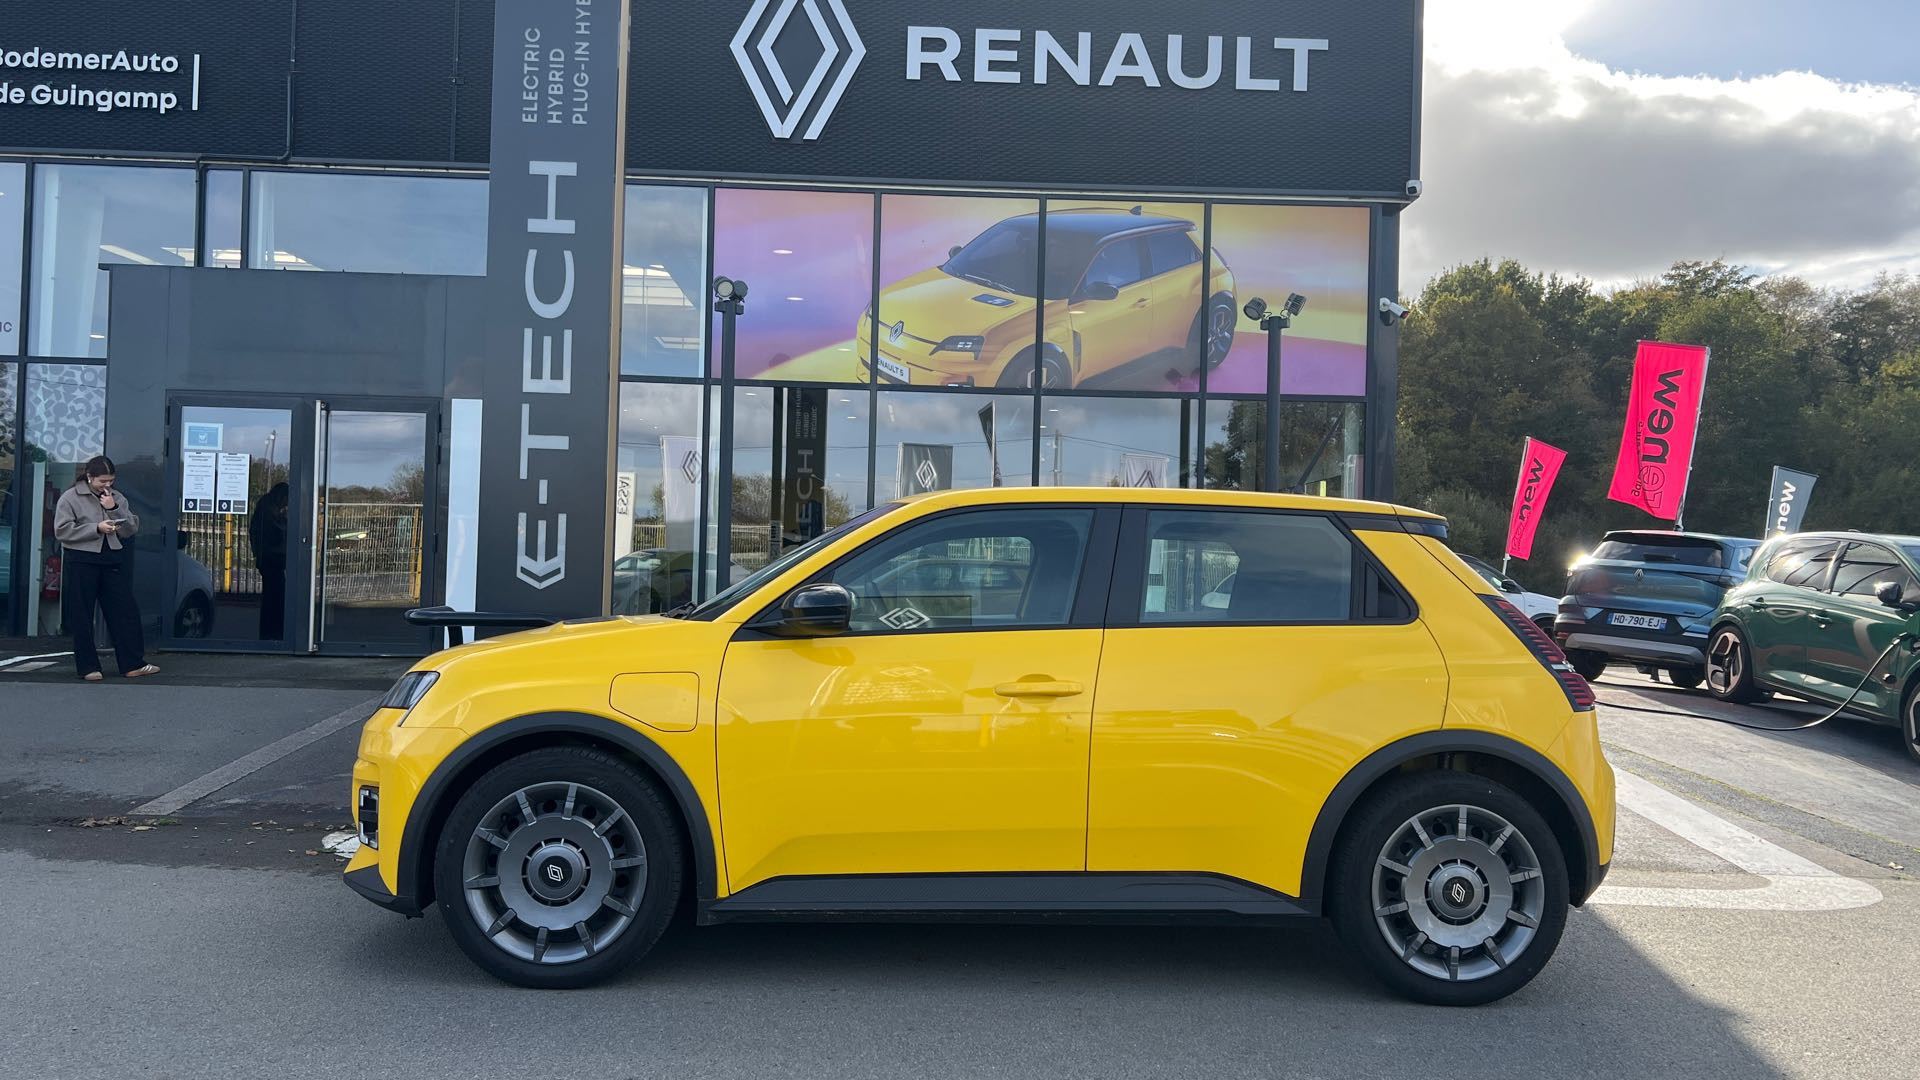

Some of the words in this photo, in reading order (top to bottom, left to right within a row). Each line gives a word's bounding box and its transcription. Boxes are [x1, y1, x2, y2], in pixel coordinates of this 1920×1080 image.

[0, 46, 179, 72] odemerAuto
[522, 28, 541, 123] ELECTRIC
[547, 48, 565, 123] HYBRID
[572, 41, 590, 125] PLUG-IN
[906, 25, 1329, 91] RENAULT
[31, 84, 177, 114] Guingamp
[516, 160, 578, 590] E-TECH
